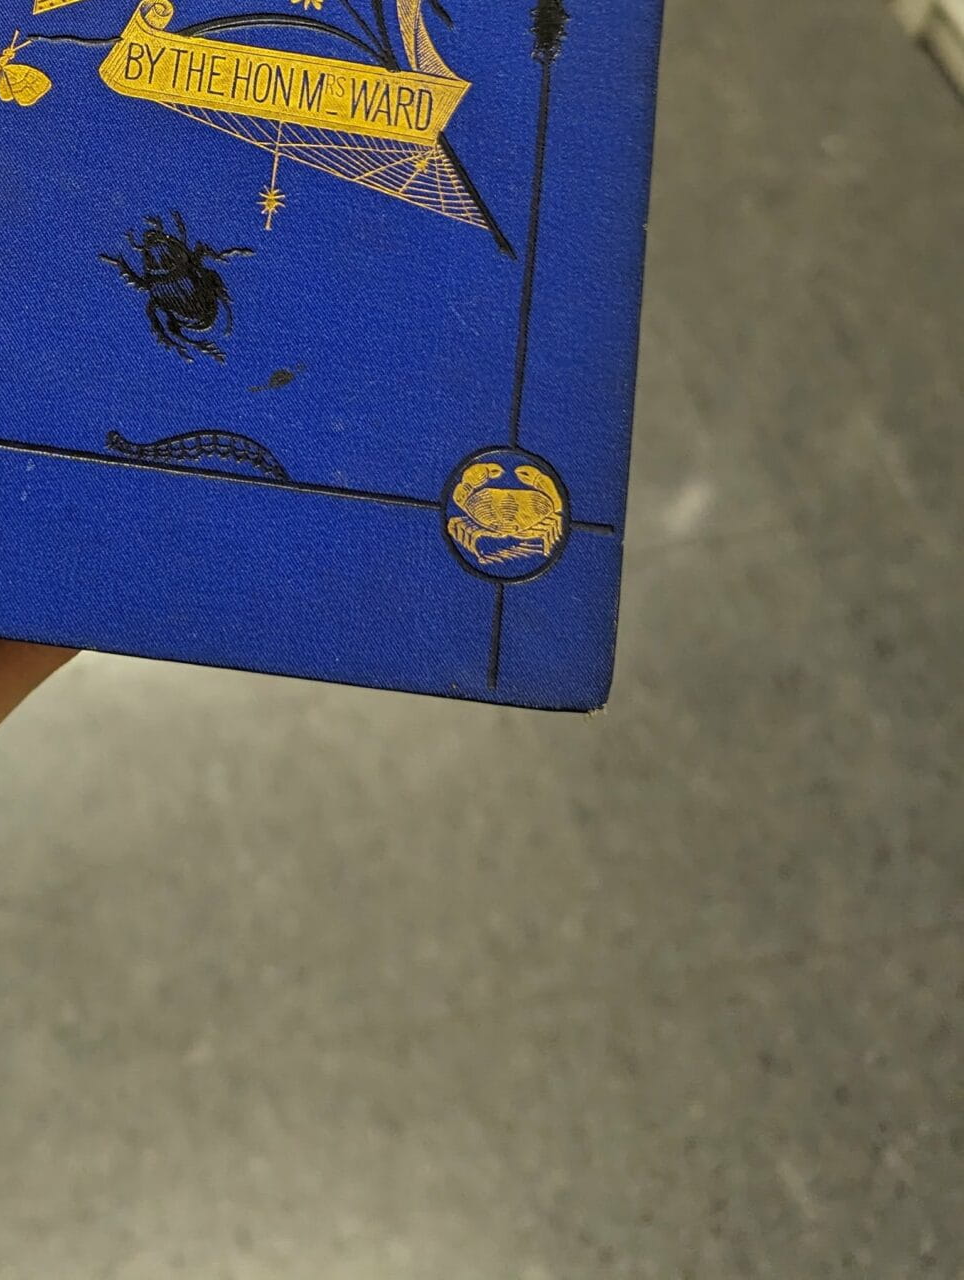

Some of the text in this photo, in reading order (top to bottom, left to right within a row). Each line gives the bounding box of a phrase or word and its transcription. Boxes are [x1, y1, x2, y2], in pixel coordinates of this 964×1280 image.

[124, 41, 167, 85] BY
[170, 47, 227, 97] THE
[230, 57, 294, 108] HON
[350, 77, 434, 132] WARD
